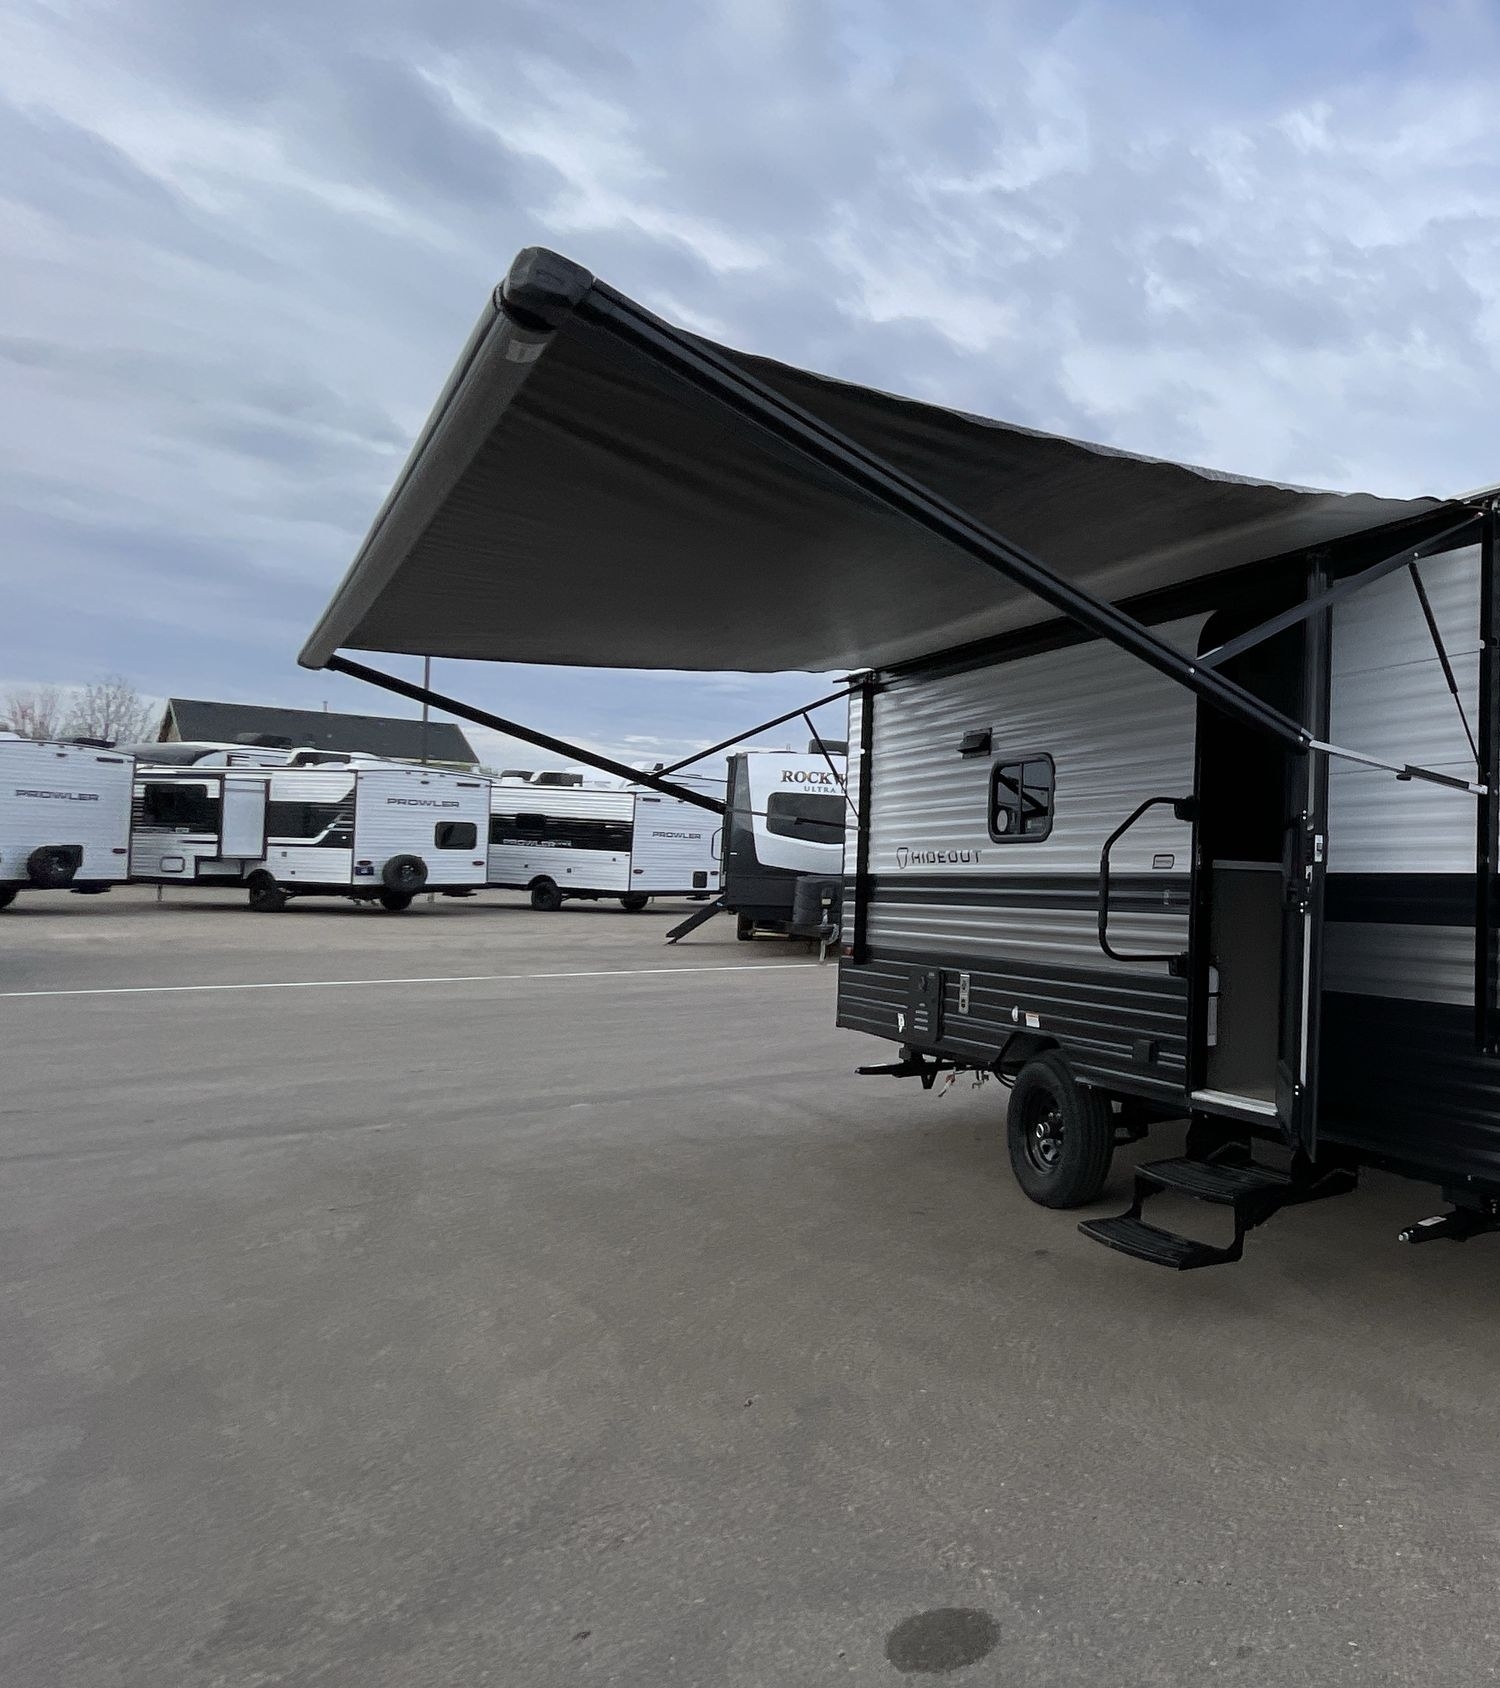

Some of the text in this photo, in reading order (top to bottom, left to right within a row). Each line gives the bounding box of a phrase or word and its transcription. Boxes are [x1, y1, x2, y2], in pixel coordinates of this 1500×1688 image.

[804, 785, 836, 793] ULTRA
[15, 789, 100, 801] PROWLER
[387, 798, 460, 808] PROWLER
[652, 831, 701, 839] PROWLER
[911, 850, 982, 864] HIDEOUT
